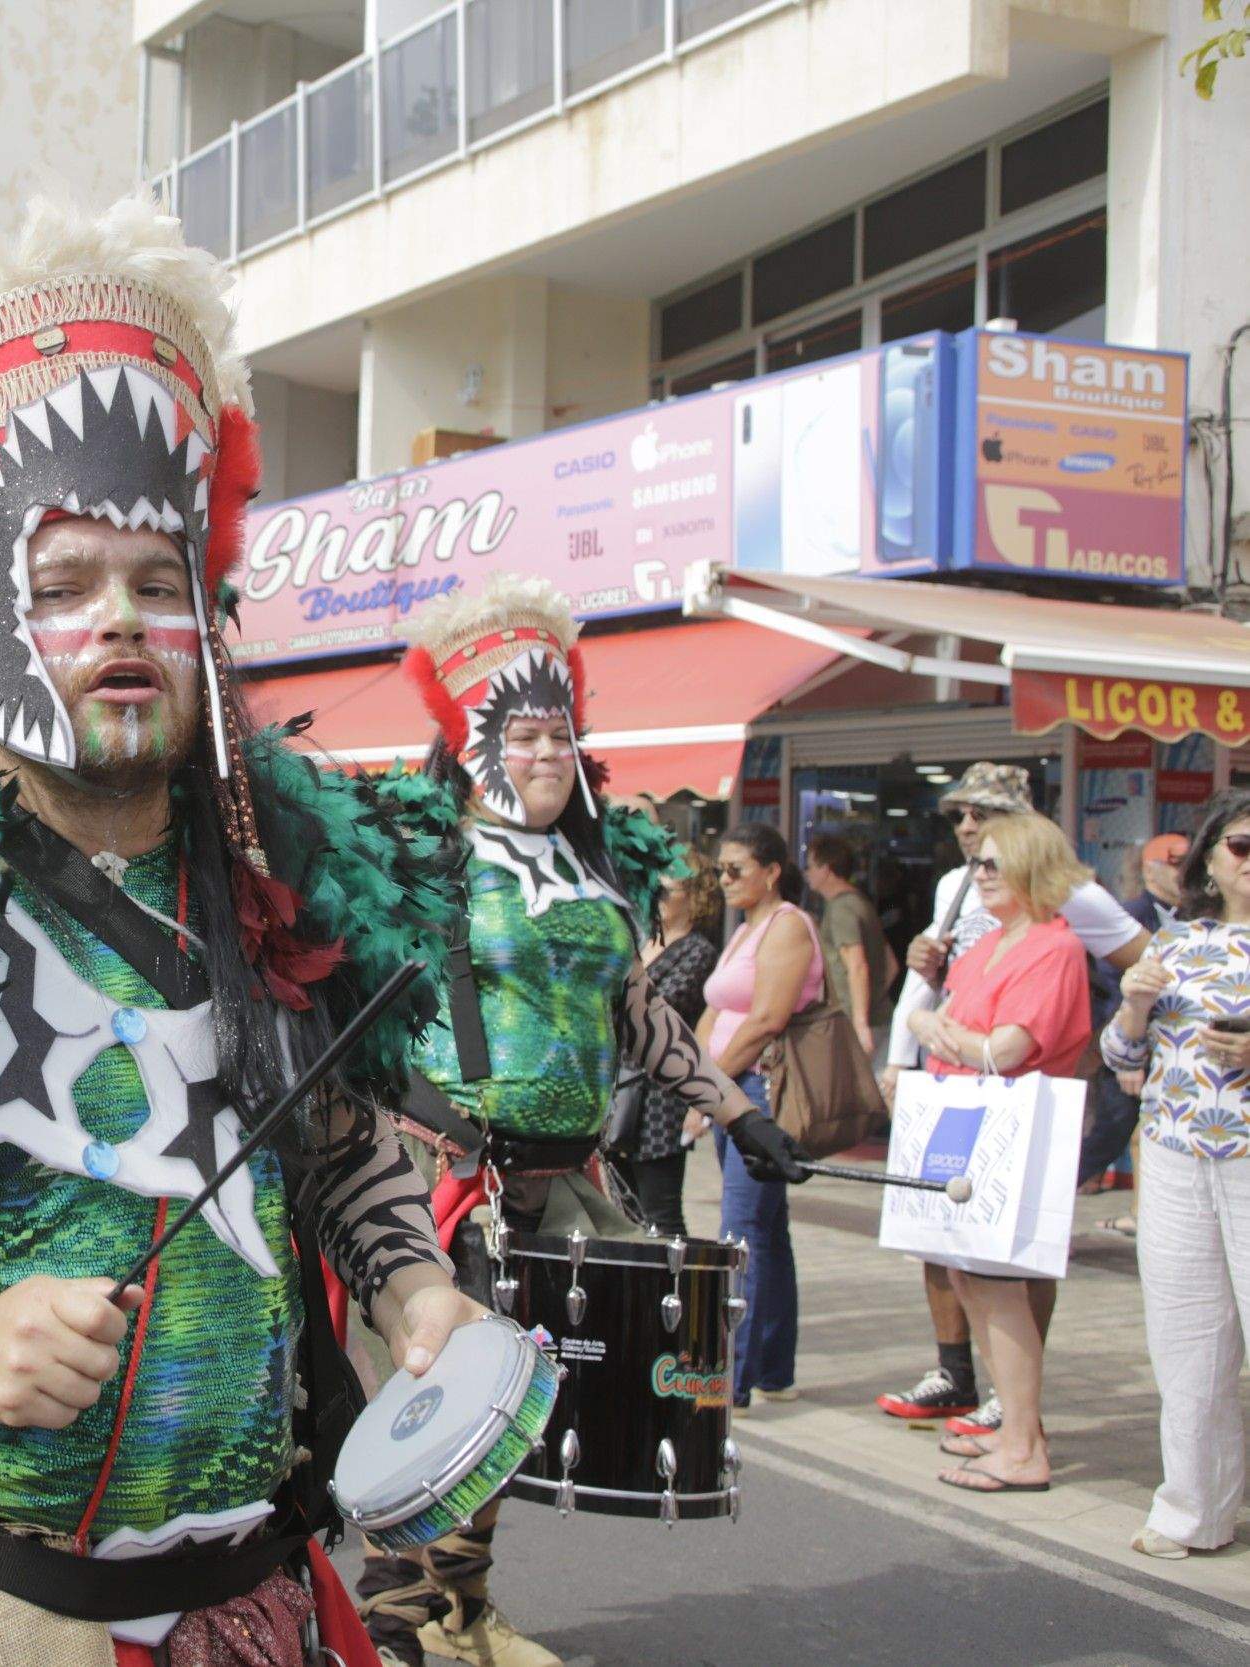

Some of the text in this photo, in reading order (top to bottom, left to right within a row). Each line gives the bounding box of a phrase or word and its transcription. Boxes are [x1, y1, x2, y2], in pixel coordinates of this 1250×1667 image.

[987, 336, 1166, 394] Sham
[1053, 385, 1165, 411] Boutique
[554, 450, 616, 479] CASIO
[631, 472, 718, 510] SAMSUNG
[244, 489, 518, 601] Sham
[569, 527, 604, 561] JBL
[298, 574, 459, 623] Boutique
[1065, 678, 1245, 732] LICOR &
